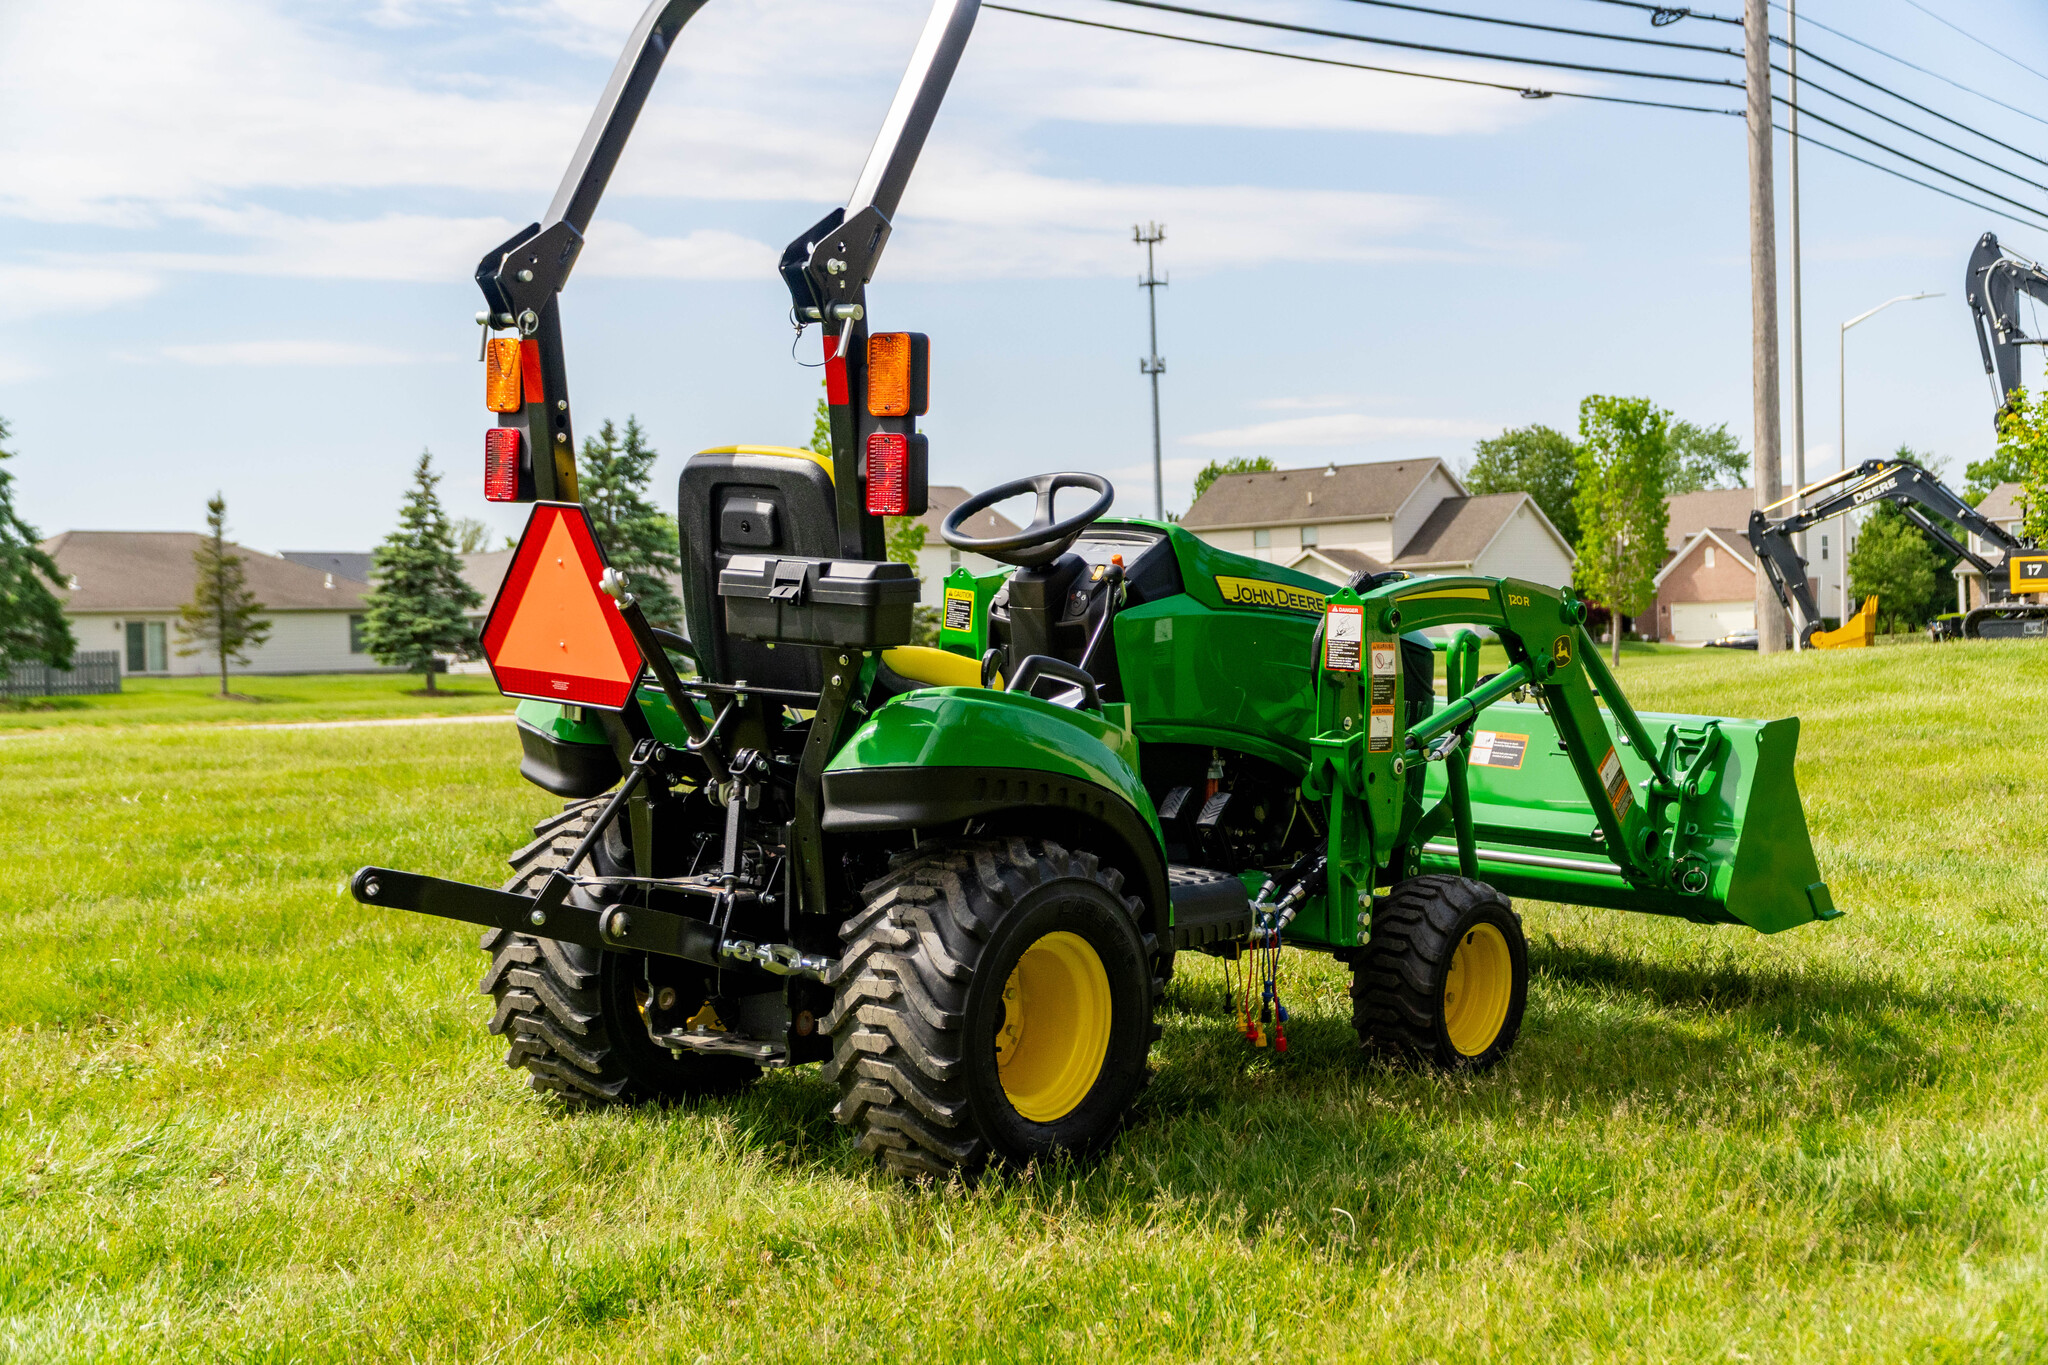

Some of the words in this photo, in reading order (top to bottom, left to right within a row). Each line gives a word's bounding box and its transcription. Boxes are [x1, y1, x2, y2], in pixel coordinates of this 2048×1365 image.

[1853, 477, 1898, 505] DEERE
[2026, 563, 2043, 576] 17
[954, 590, 972, 599] CAUTION
[1233, 583, 1275, 604] JOHN
[1276, 588, 1325, 611] DEERE
